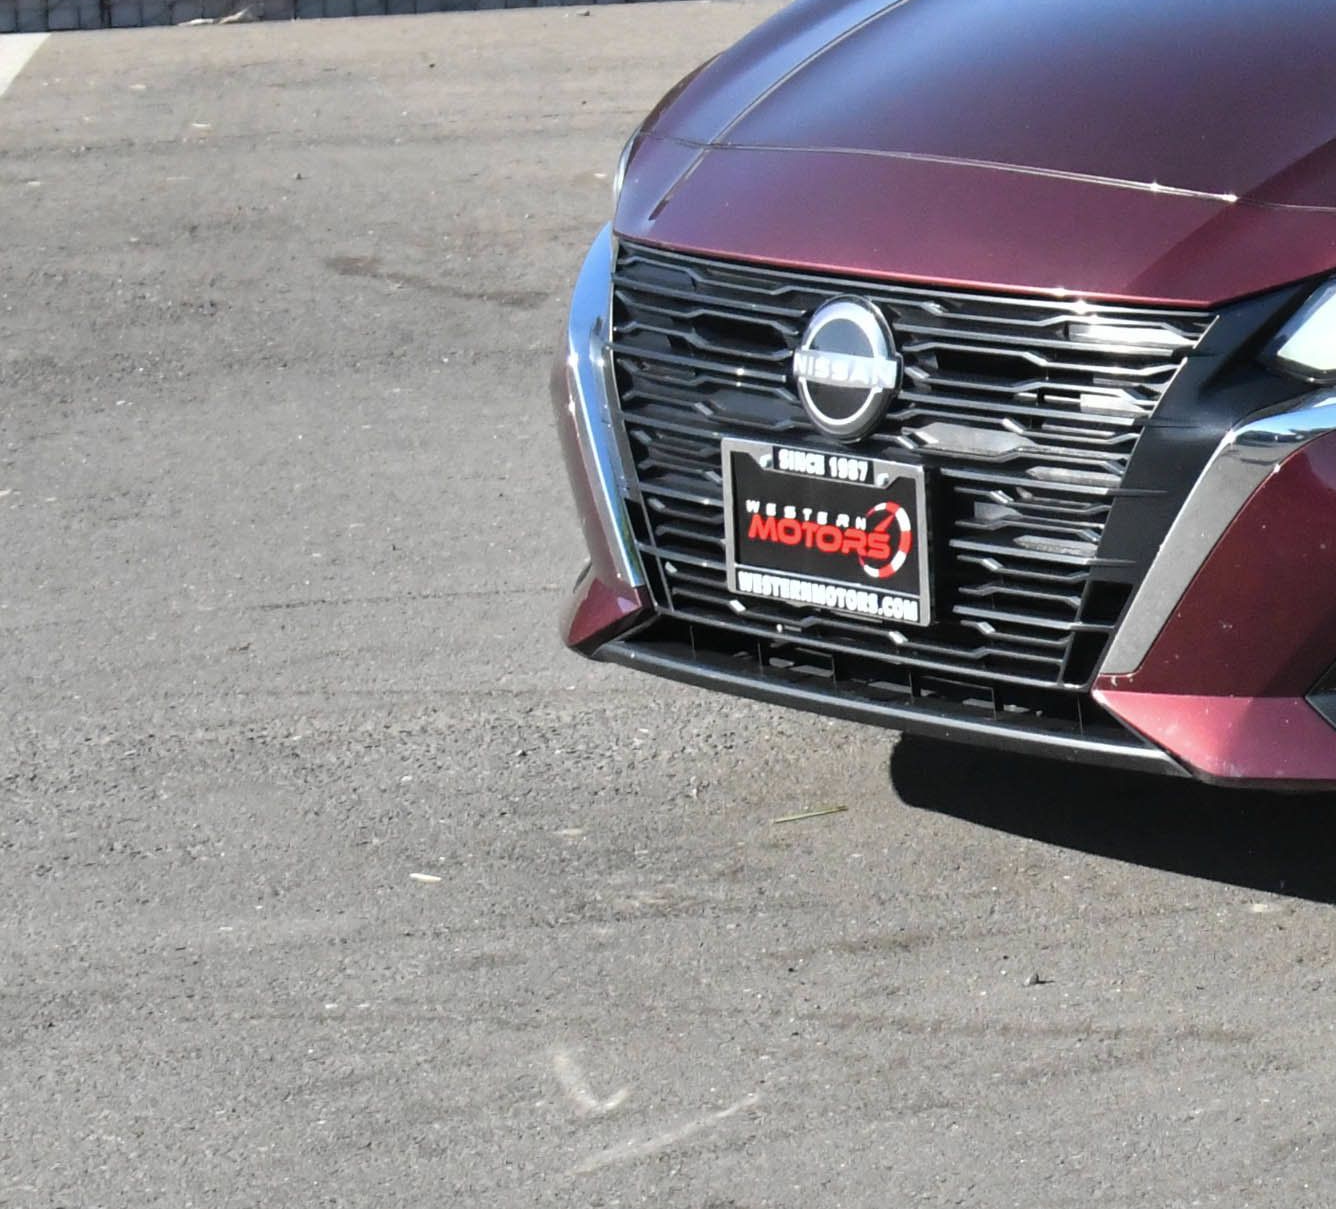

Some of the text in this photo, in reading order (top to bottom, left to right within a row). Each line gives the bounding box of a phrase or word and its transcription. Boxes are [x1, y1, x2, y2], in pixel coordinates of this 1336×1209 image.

[798, 350, 897, 389] NISSAN
[746, 498, 867, 530] WESTERN
[748, 513, 892, 560] MOTORS
